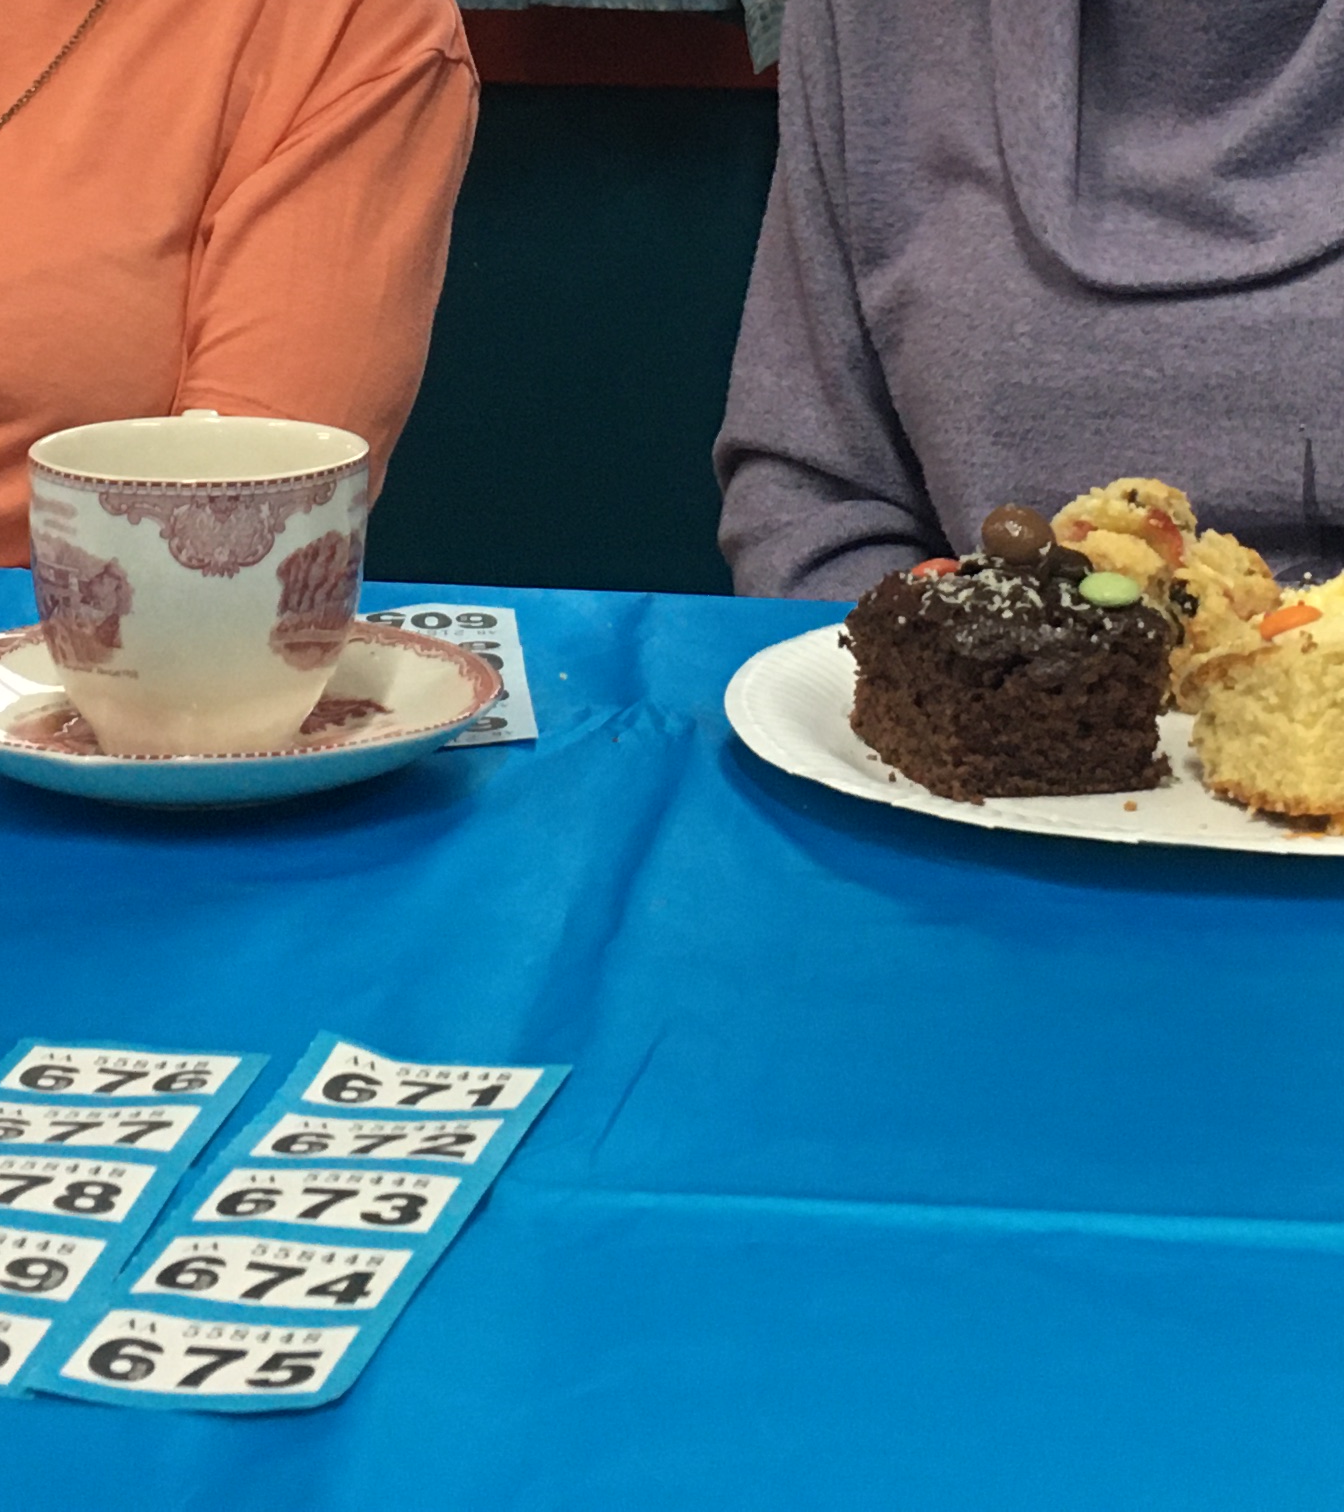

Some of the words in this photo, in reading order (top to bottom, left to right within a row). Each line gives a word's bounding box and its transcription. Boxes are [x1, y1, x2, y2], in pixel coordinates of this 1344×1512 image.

[366, 611, 497, 629] 605
[18, 1064, 213, 1093] 676
[321, 1073, 505, 1107] 671
[271, 1132, 477, 1158] 672
[216, 1188, 429, 1225] 673
[155, 1256, 375, 1305] 674
[88, 1338, 324, 1388] 675
